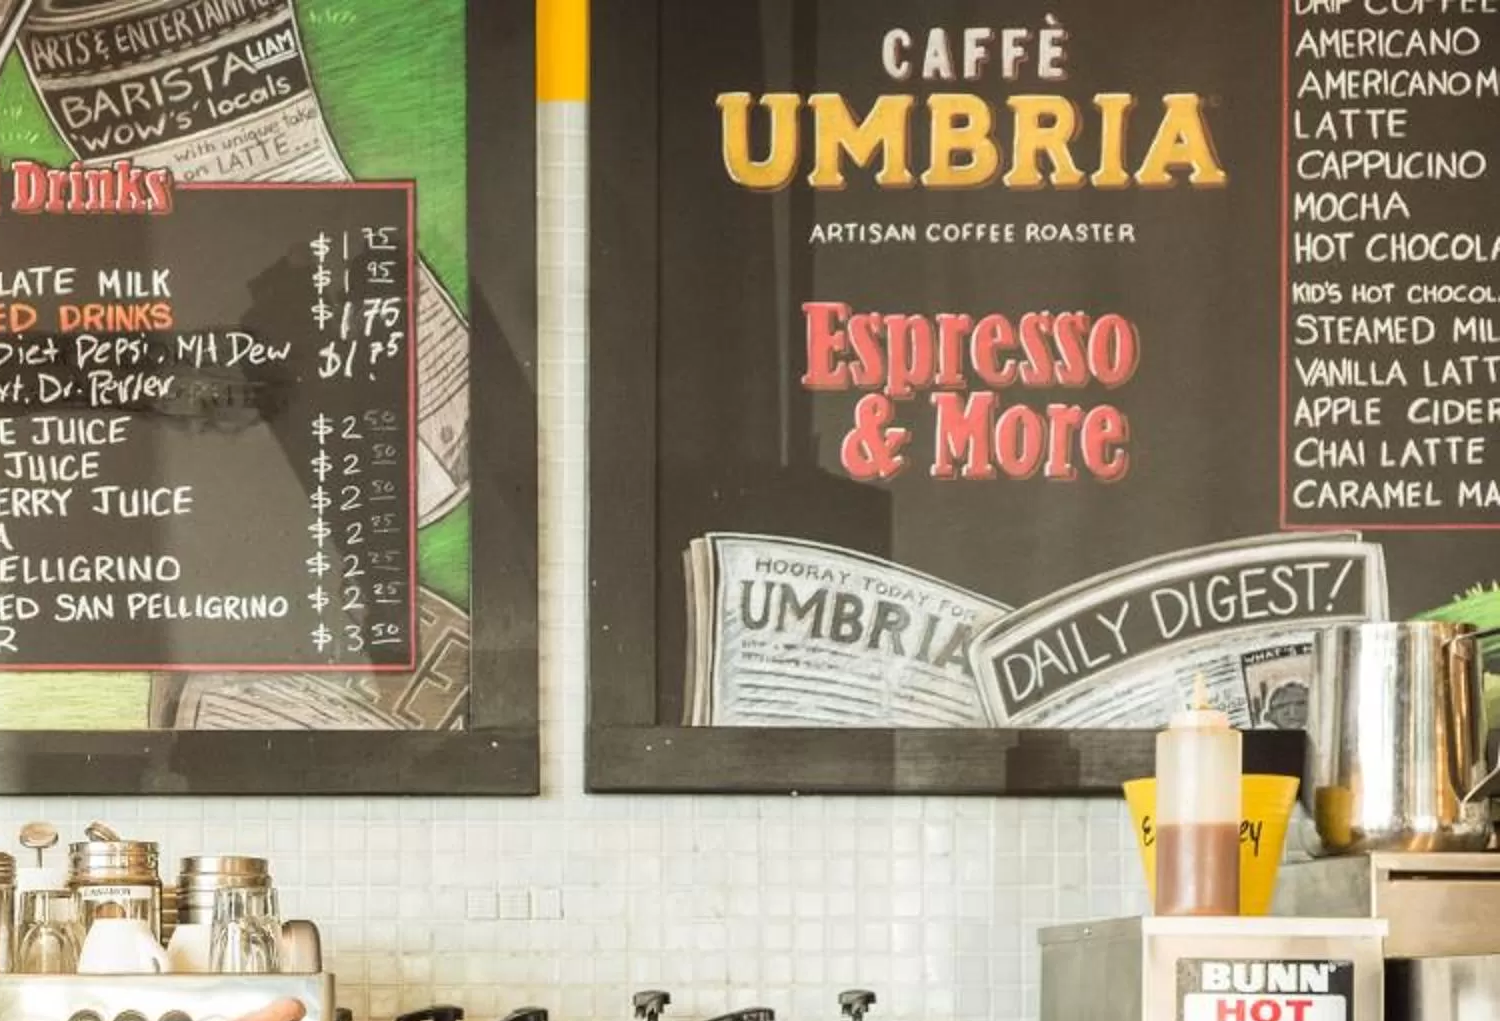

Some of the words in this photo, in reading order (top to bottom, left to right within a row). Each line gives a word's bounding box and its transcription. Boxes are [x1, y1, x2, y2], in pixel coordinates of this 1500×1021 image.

[30, 31, 91, 72] ARTS
[881, 14, 1071, 81] CAFFÈ
[1295, 27, 1481, 59] AMERICANO
[60, 52, 256, 129] BARISTA
[246, 30, 295, 62] LIAM
[1297, 68, 1472, 101] AMERICANO
[207, 73, 291, 120] locals
[1294, 108, 1408, 141] LATTE
[715, 91, 1229, 192] UMBRIA
[1297, 151, 1487, 180] CAPPUCINO
[12, 160, 174, 214] Drinks
[1294, 192, 1410, 222] MOCHA
[809, 222, 917, 244] ARTISAN
[926, 222, 1016, 244] COFFEE
[1025, 222, 1136, 244] ROASTER
[1294, 233, 1353, 263] HOT
[99, 269, 171, 298] MILK
[1292, 282, 1342, 304] KID'S
[1352, 284, 1394, 304] HOT
[60, 303, 173, 328] DRINKS
[1295, 314, 1434, 345] STEAMED
[227, 333, 290, 364] Dew
[801, 301, 1142, 399] Espresso
[1295, 358, 1407, 387] VANILLA
[1294, 397, 1381, 427] APPLE
[1407, 398, 1500, 429] CIDER
[31, 416, 131, 445] JUICE
[840, 392, 913, 481] &
[929, 391, 1130, 482] More
[4, 452, 100, 482] JUICE
[1294, 438, 1365, 468] CHAI
[1381, 437, 1486, 468] LATTE
[92, 486, 193, 516] JUICE
[1293, 480, 1441, 509] CARAMEL
[755, 558, 851, 585] HOORAY
[862, 575, 929, 607] TODAY
[55, 595, 114, 620] SAN
[129, 594, 289, 620] PELLIGRINO
[740, 579, 977, 676] UMBRIA
[1002, 601, 1129, 702] DAILY
[1150, 559, 1353, 640] DIGEST!
[1201, 962, 1329, 993] BUNN
